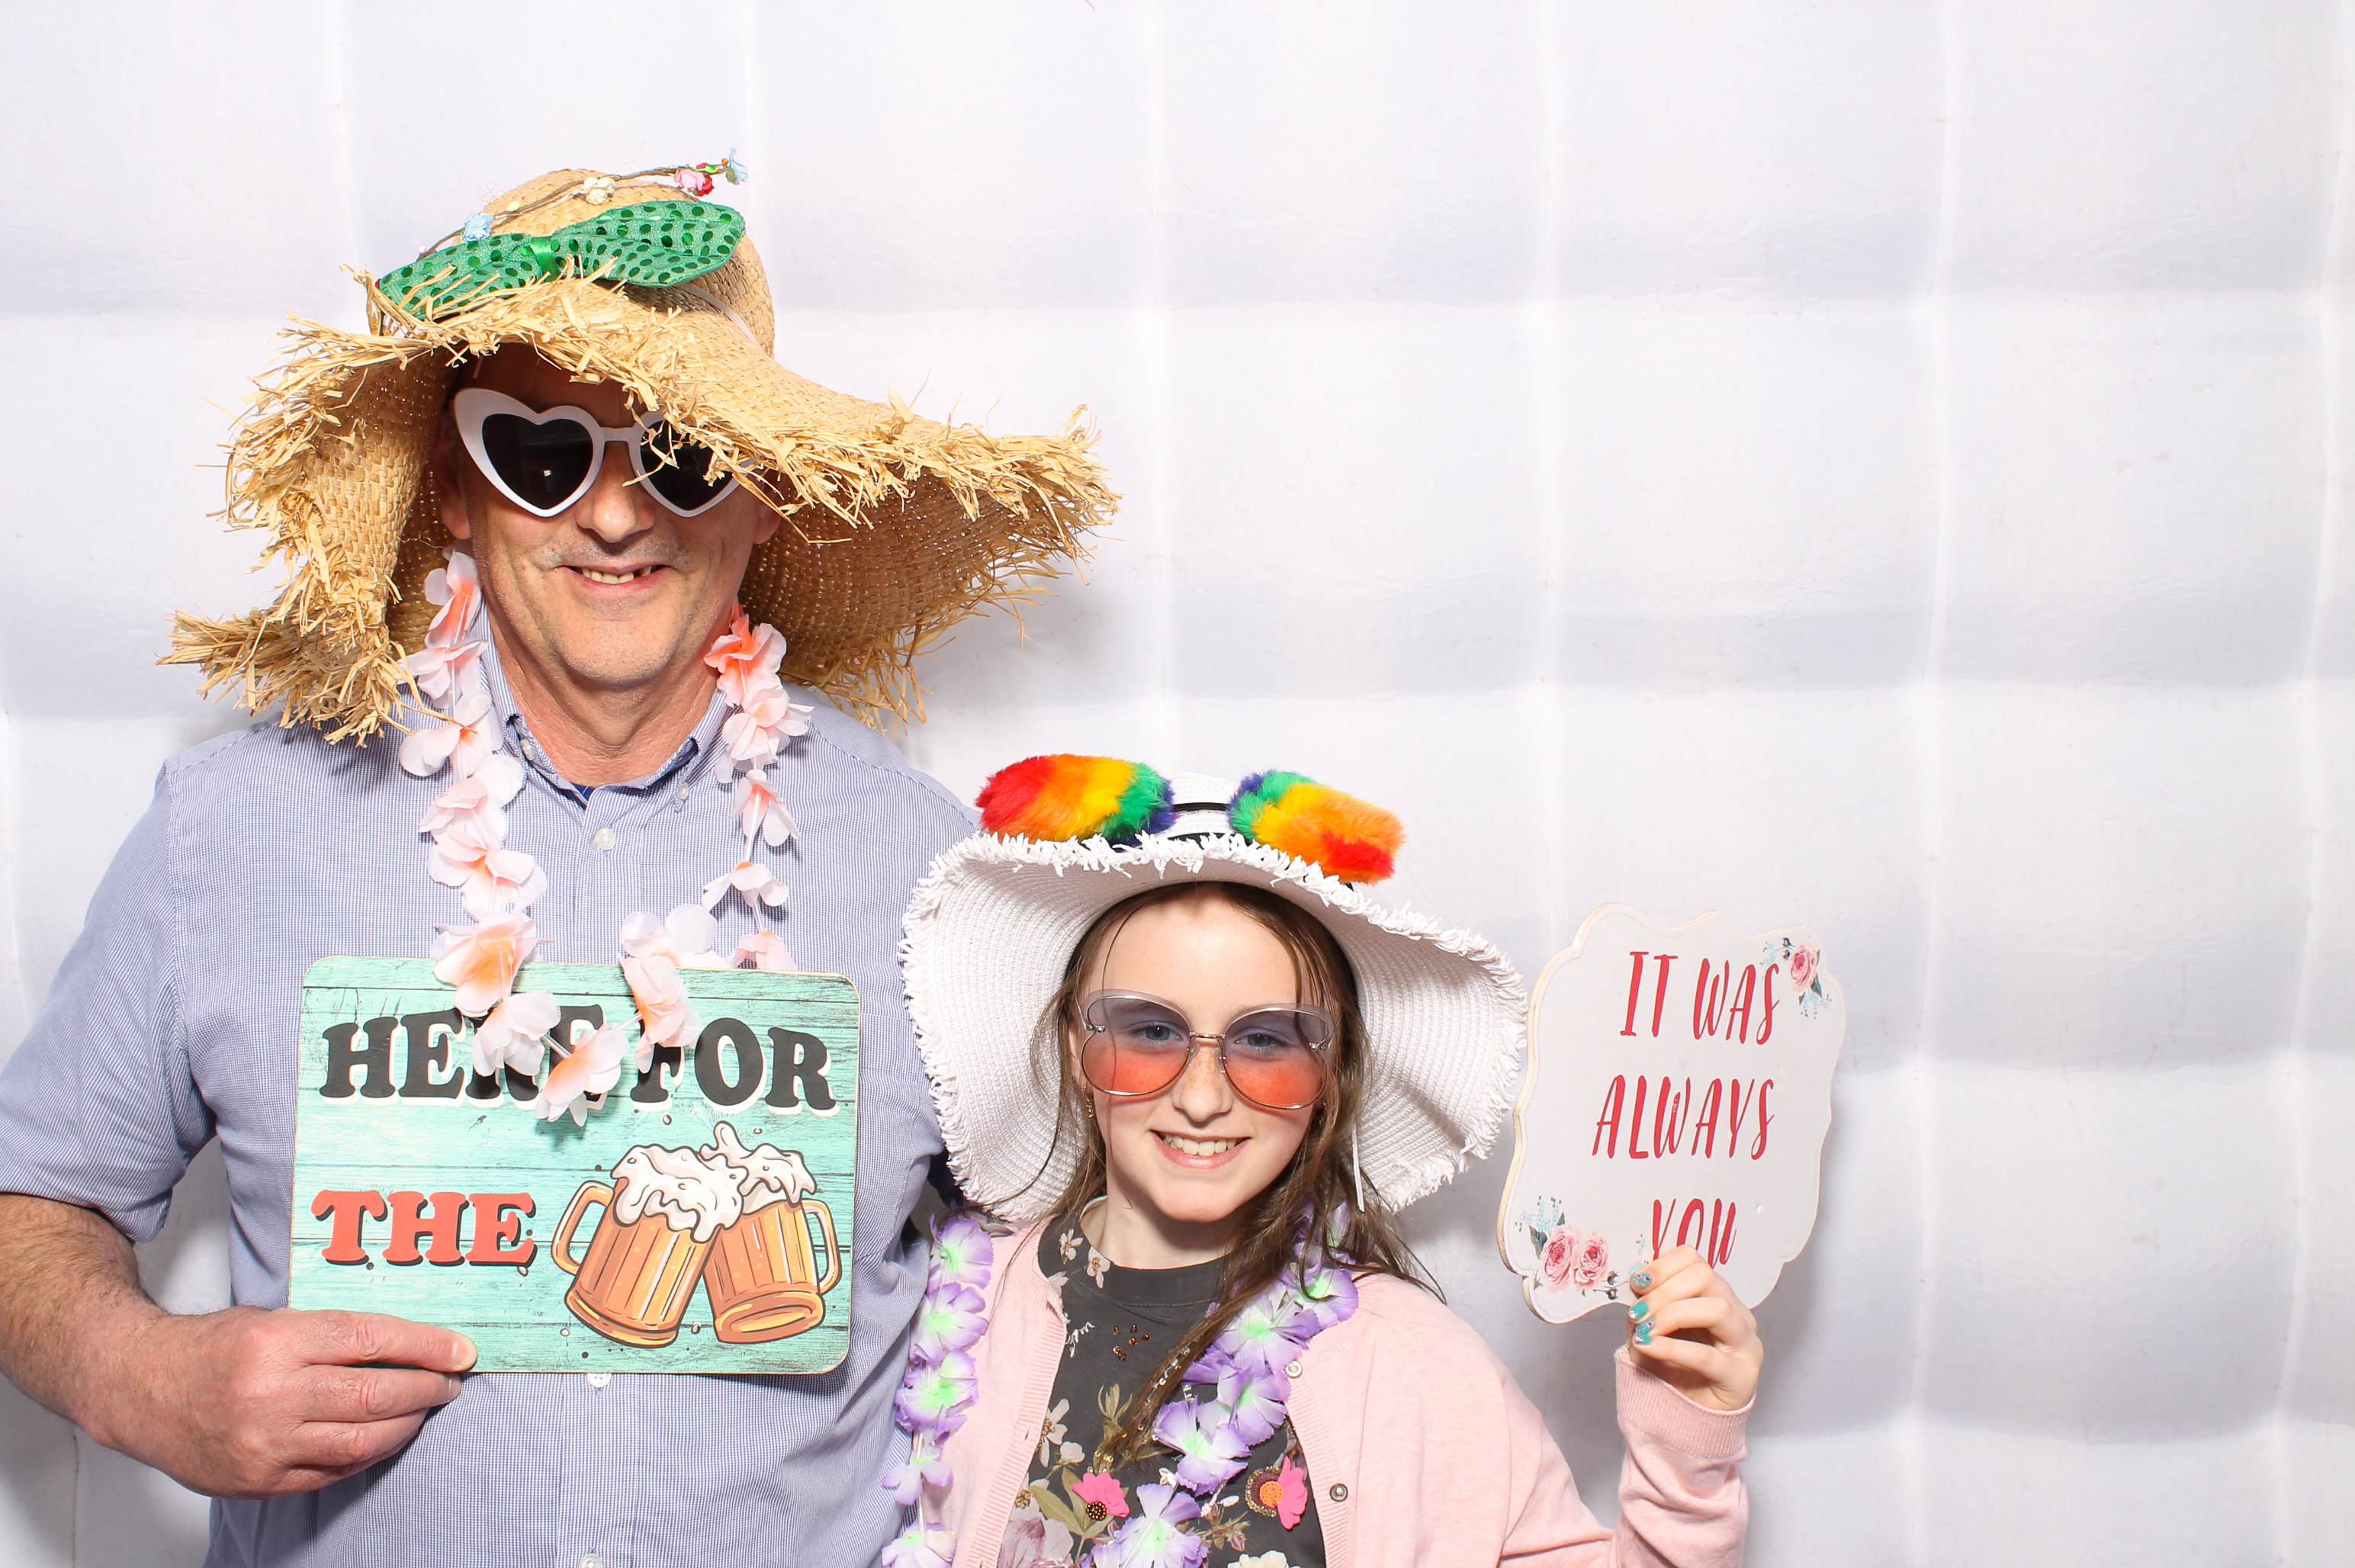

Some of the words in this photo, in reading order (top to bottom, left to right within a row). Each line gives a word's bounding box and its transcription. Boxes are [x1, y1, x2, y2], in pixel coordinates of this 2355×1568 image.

[1620, 951, 1679, 1037] IT
[1693, 958, 1780, 1045] WAS
[1592, 1075, 1775, 1160] ALWAYS
[310, 1189, 536, 1266] THE
[1653, 1198, 1737, 1269] YOU
